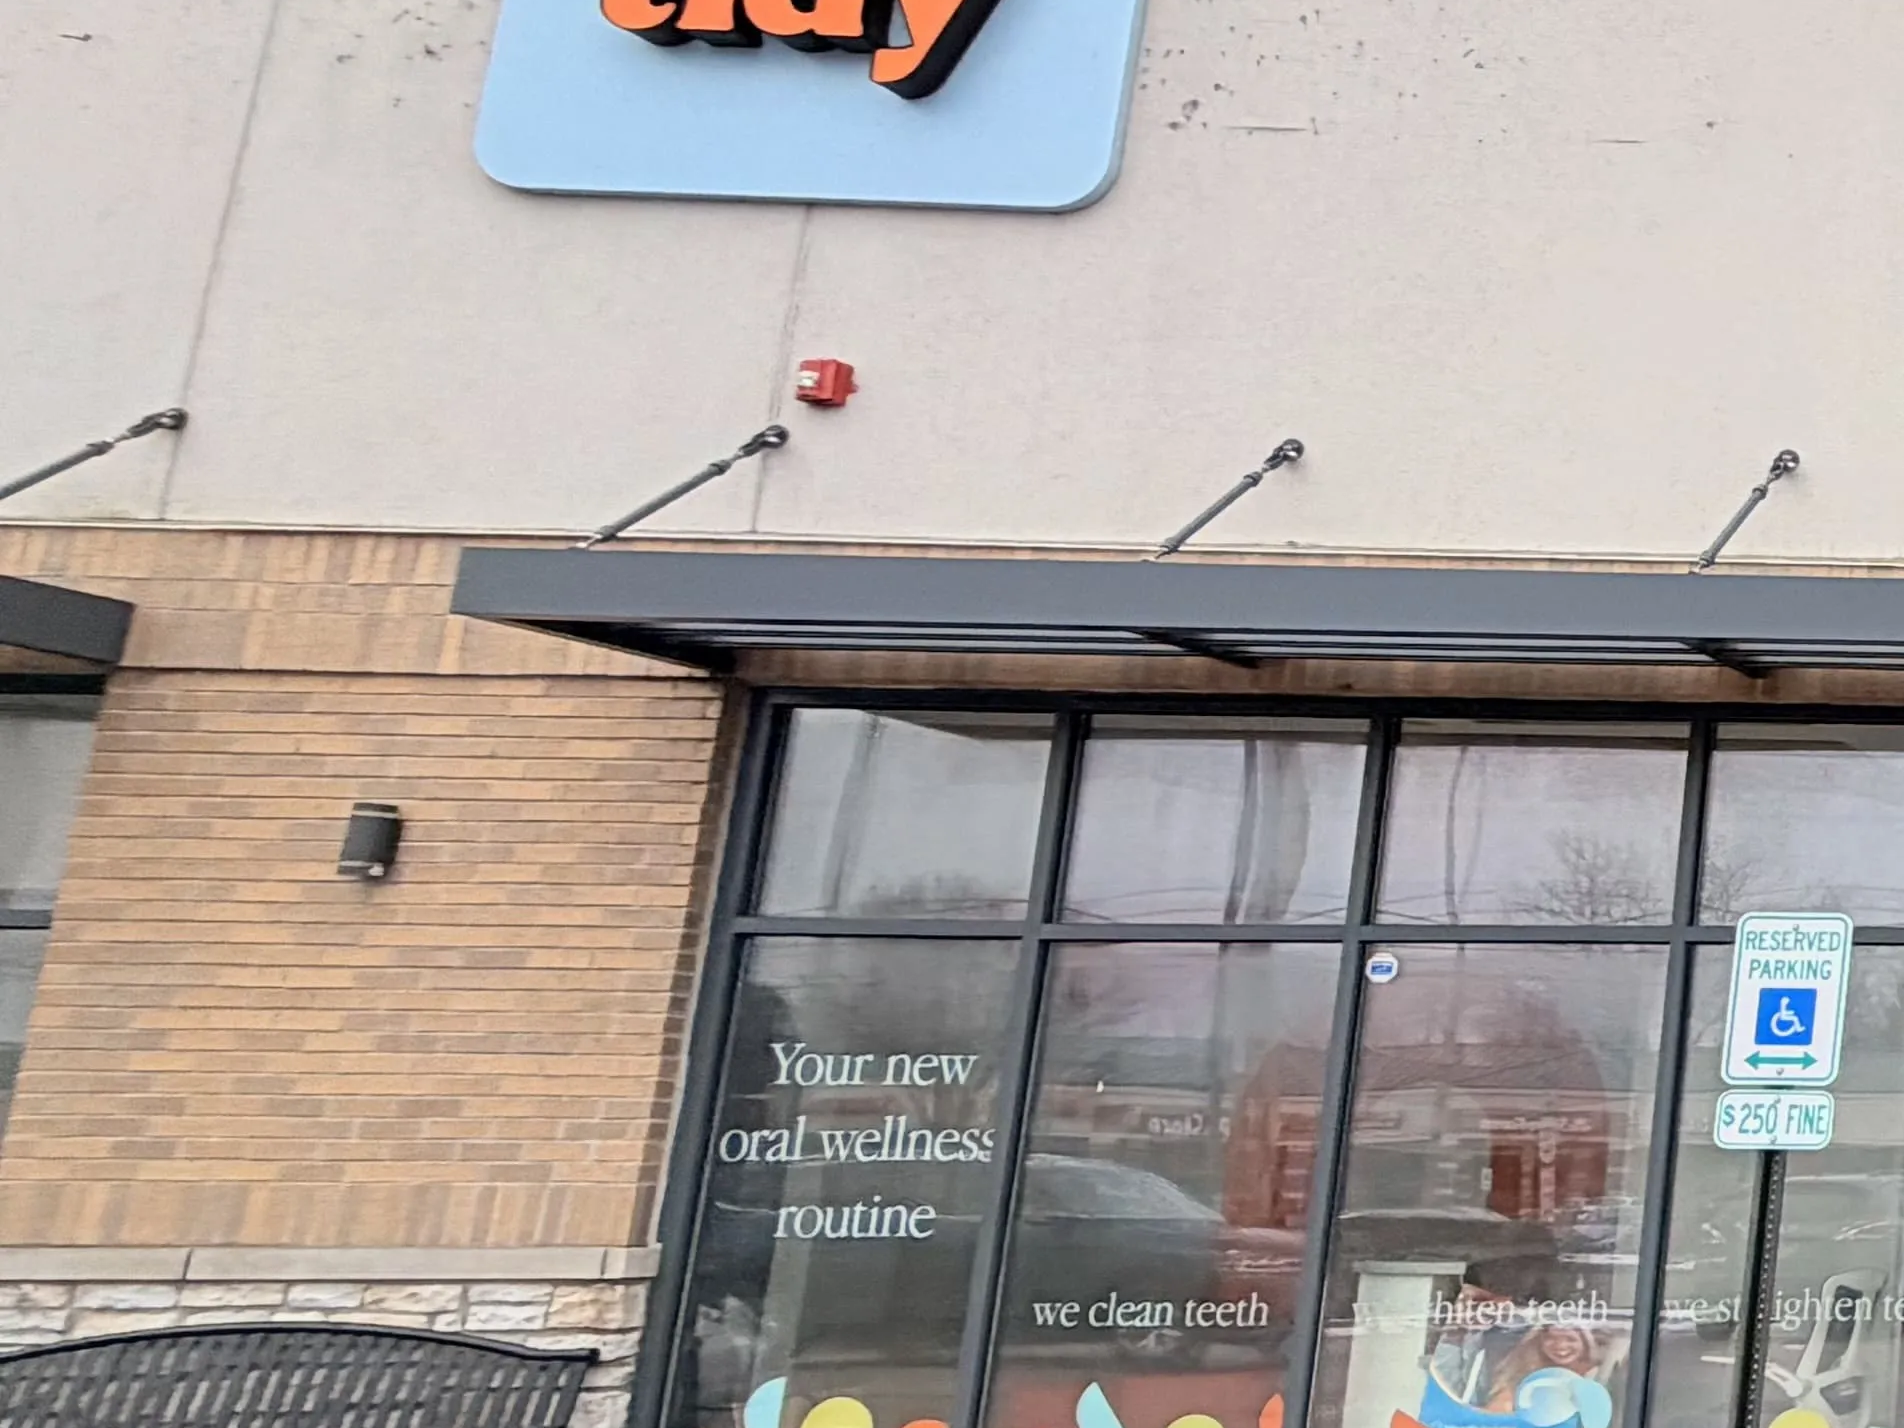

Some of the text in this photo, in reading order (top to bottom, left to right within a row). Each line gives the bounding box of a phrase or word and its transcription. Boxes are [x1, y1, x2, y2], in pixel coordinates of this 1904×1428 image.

[1745, 930, 1841, 952] RESERVED
[1748, 959, 1833, 980] PARKING
[768, 1042, 979, 1086] Your new
[1785, 1104, 1829, 1135] FINE
[719, 1115, 807, 1162] oral
[772, 1196, 937, 1239] routine
[1032, 1291, 1269, 1328] we clean teeth
[1525, 1289, 1608, 1325] teeth
[1713, 1288, 1873, 1332] stighten
